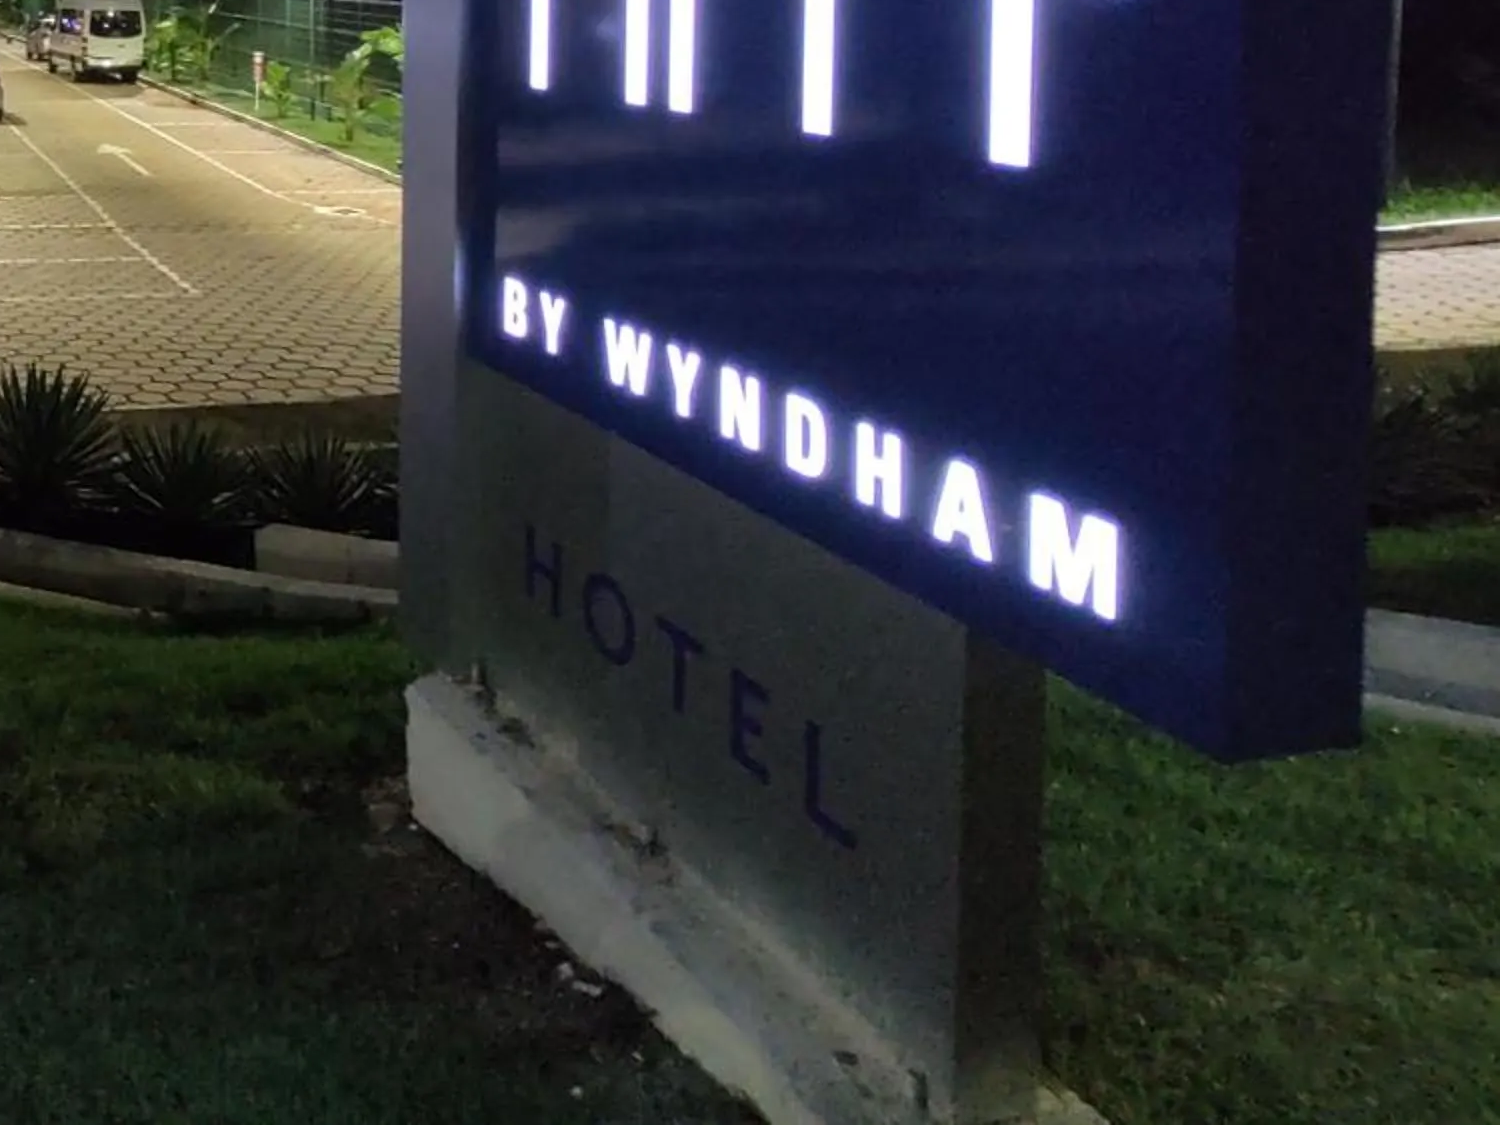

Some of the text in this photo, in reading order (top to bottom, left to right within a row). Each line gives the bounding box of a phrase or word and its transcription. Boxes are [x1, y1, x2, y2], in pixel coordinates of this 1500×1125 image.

[501, 275, 1121, 623] BY WYNDHAM
[525, 524, 857, 849] HOTEL
